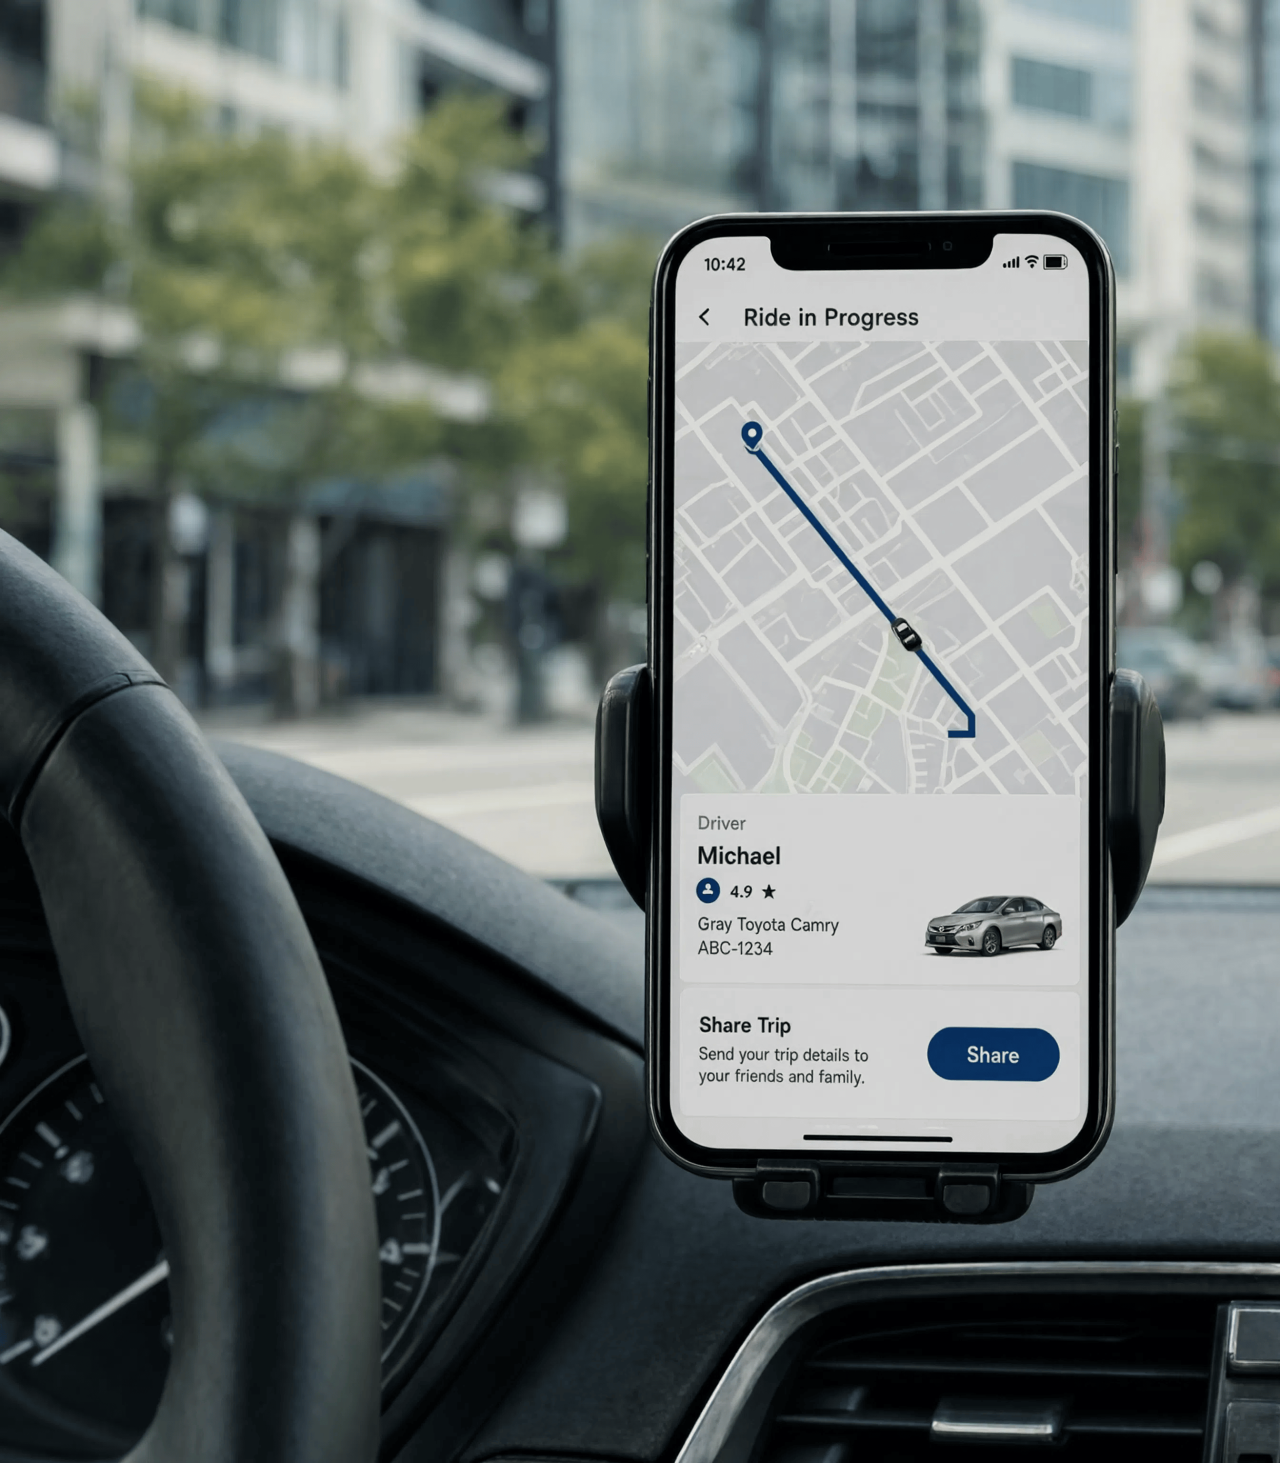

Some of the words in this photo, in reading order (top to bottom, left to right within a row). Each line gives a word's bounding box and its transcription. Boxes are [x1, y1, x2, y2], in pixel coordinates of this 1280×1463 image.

[704, 256, 746, 272] 10:42
[744, 306, 791, 327] Ride
[798, 307, 817, 327] in
[825, 307, 919, 332] Progress
[698, 815, 747, 831] Driver
[698, 845, 781, 866] Michael
[729, 884, 753, 899] 4.9
[697, 916, 733, 935] Gray
[736, 916, 786, 935] Toyota
[790, 917, 840, 937] Camry
[697, 939, 774, 956] ABC-1234
[699, 1015, 752, 1034] Share
[757, 1016, 792, 1038] Trip
[698, 1046, 735, 1061] Send
[738, 1050, 770, 1065] your
[774, 1047, 799, 1065] trip
[802, 1047, 850, 1062] details
[854, 1049, 869, 1063] to
[967, 1045, 1020, 1064] Share
[698, 1071, 731, 1087] your
[734, 1068, 784, 1083] friends
[788, 1069, 814, 1084] and
[818, 1069, 865, 1088] family.
